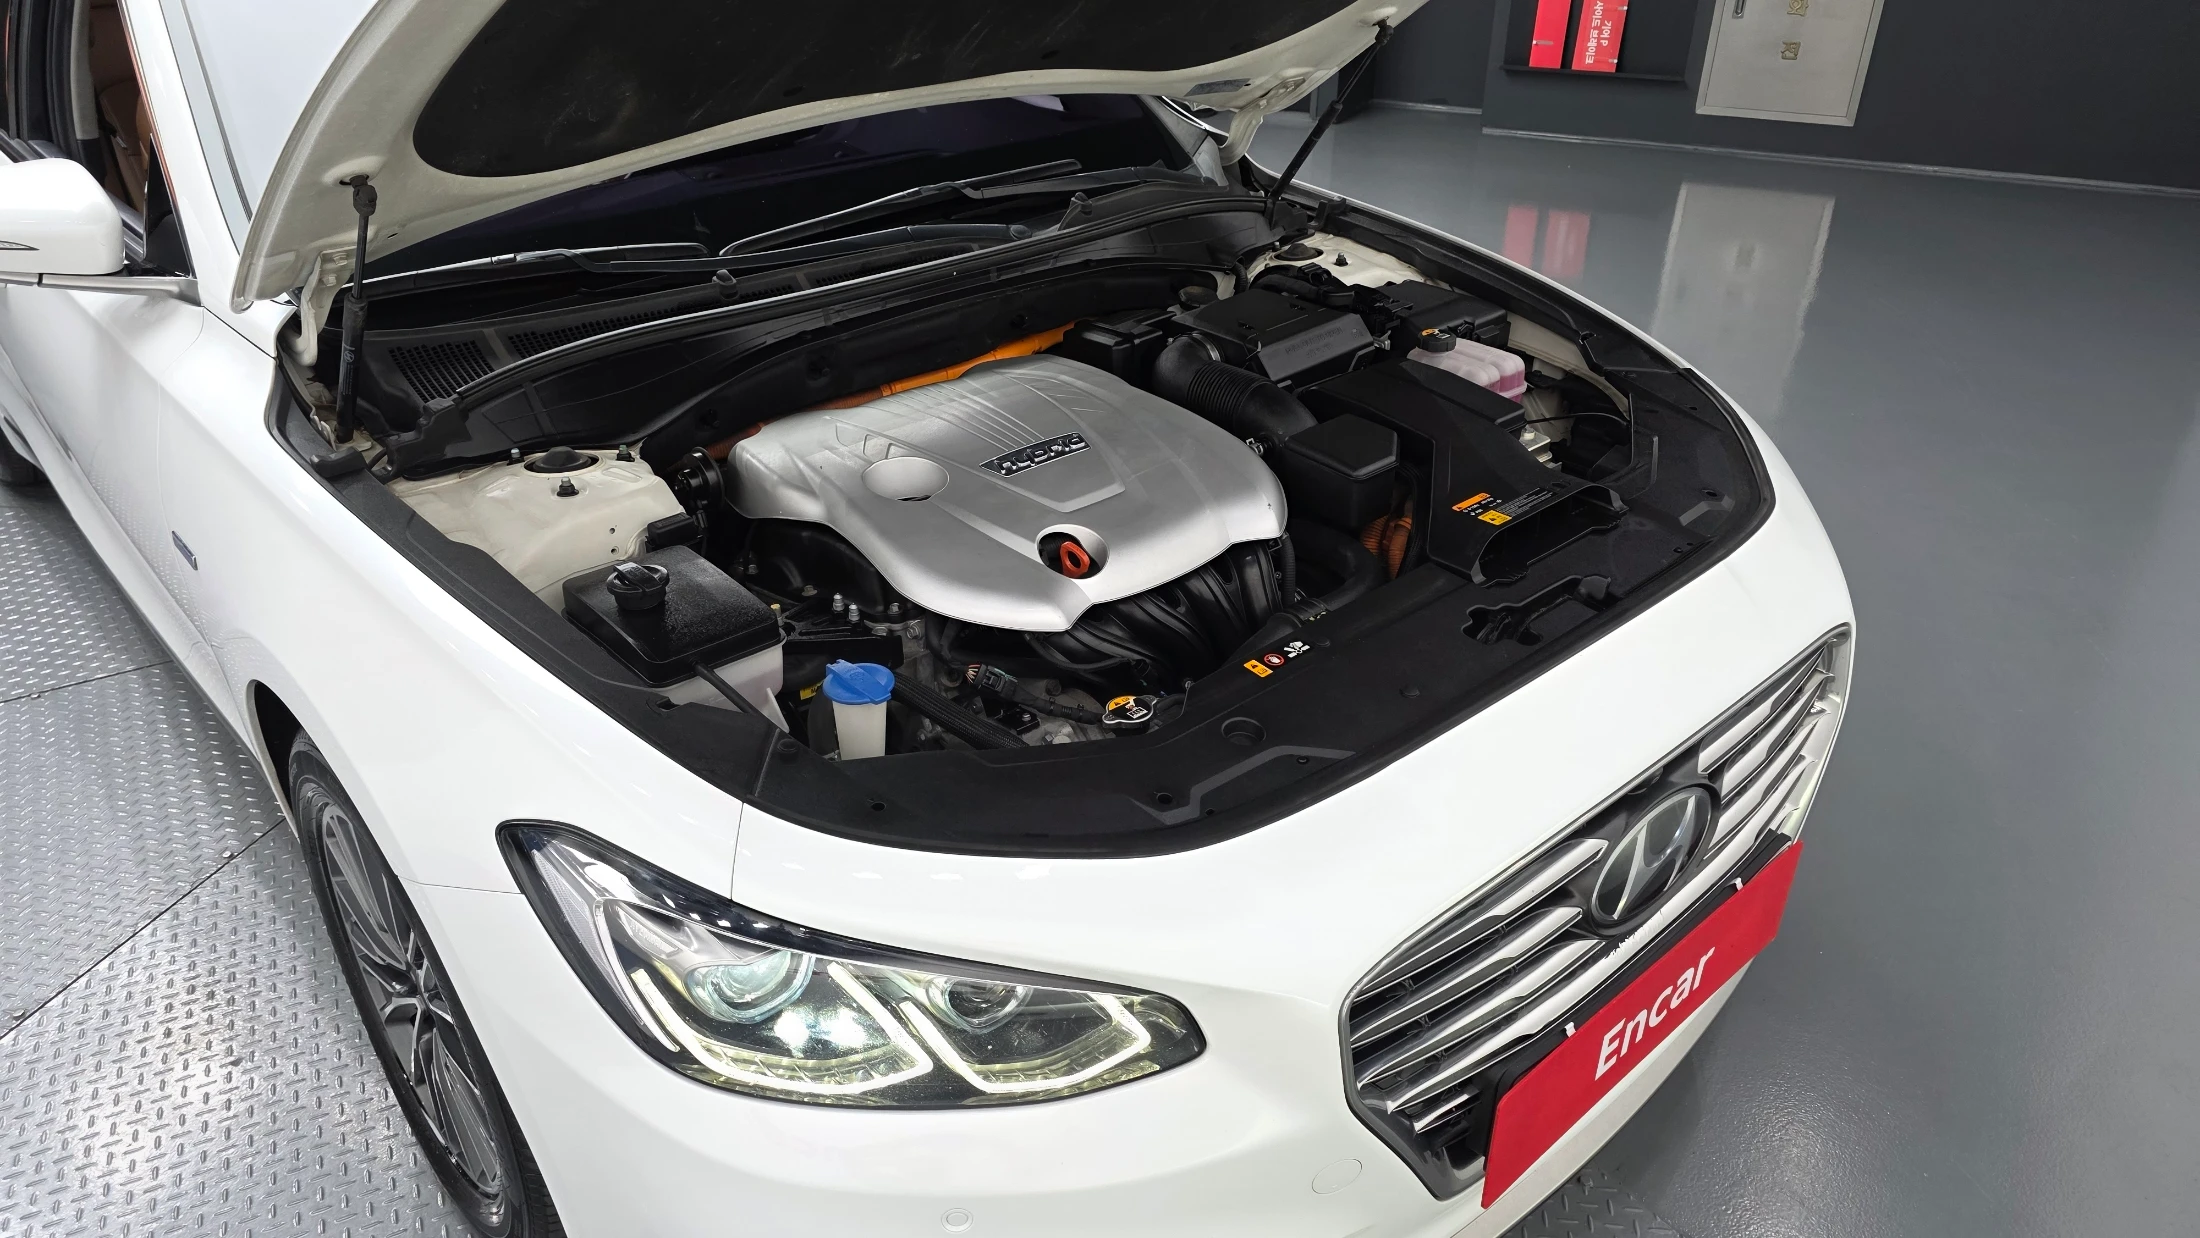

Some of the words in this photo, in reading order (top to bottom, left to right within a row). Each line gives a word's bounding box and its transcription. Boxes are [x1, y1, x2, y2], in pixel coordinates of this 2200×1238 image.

[1591, 0, 1604, 28] 사이드
[1600, 20, 1612, 38] 기어
[1600, 39, 1609, 47] P
[1585, 29, 1599, 65] 브레이크
[1594, 946, 1716, 1082] Encar
